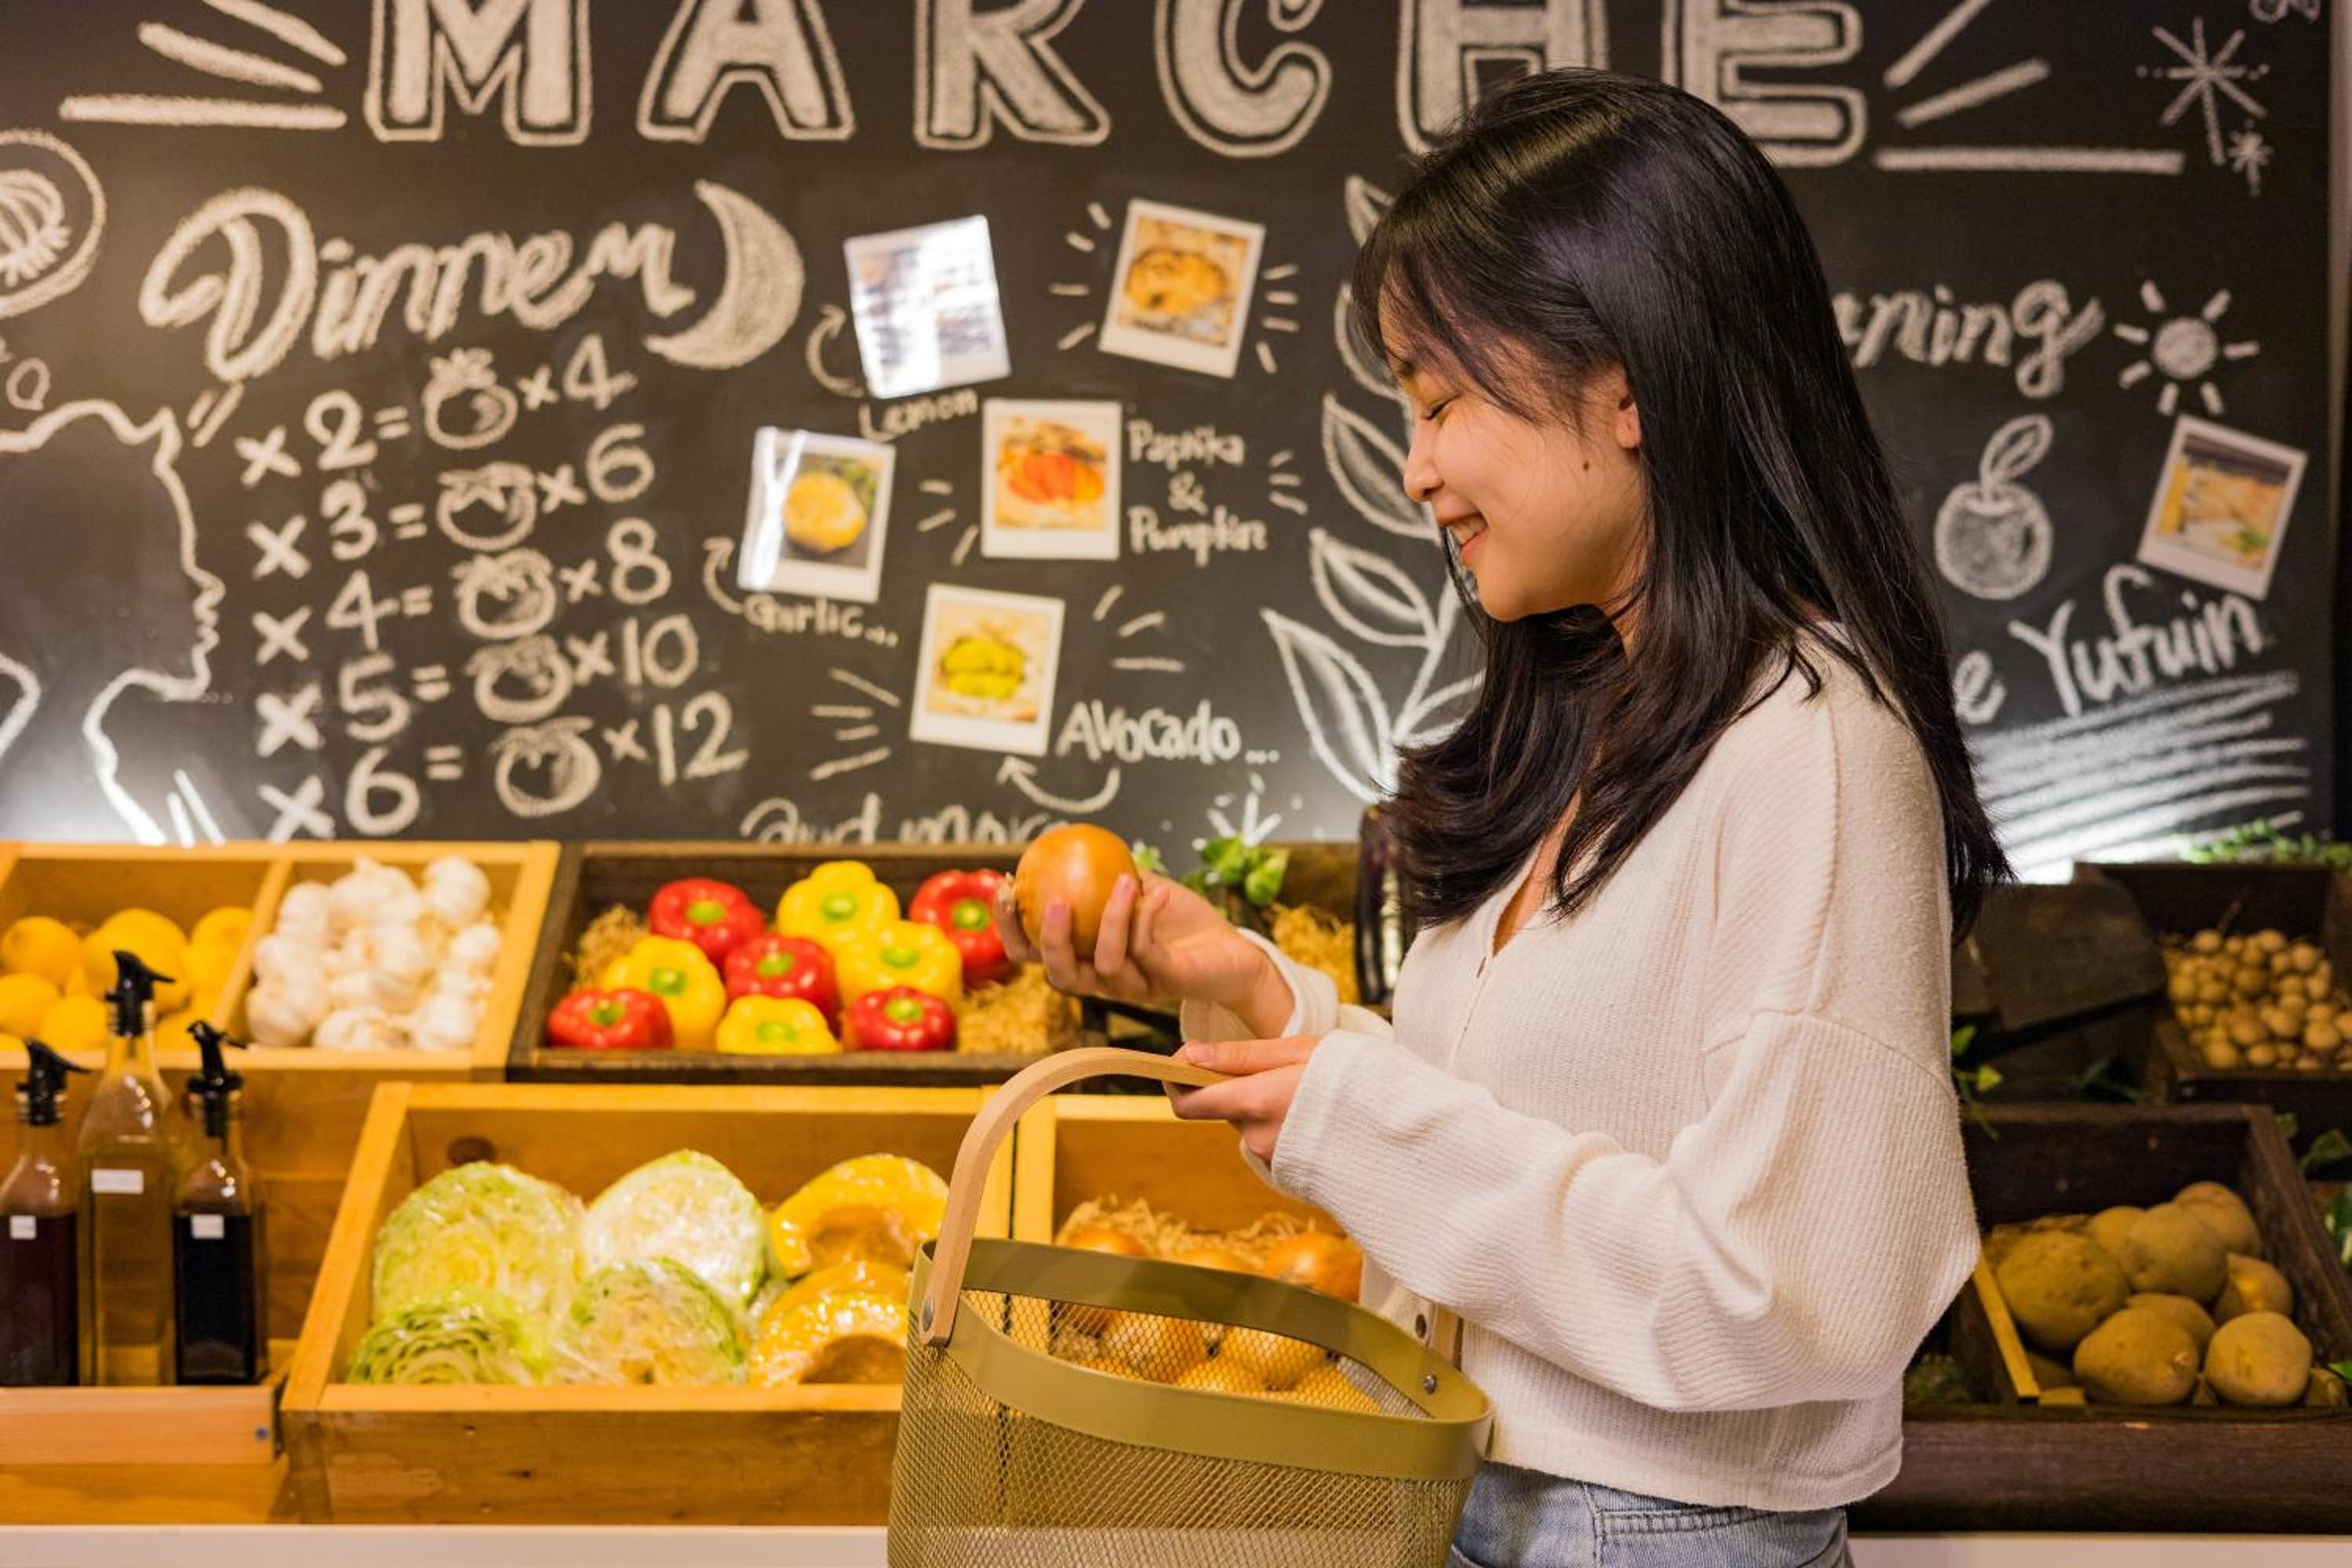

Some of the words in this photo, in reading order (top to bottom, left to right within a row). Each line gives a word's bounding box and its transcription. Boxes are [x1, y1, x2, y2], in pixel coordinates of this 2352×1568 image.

[858, 389, 978, 444] Lemon
[1168, 471, 1207, 515] &
[2009, 563, 2264, 718] Yufuin
